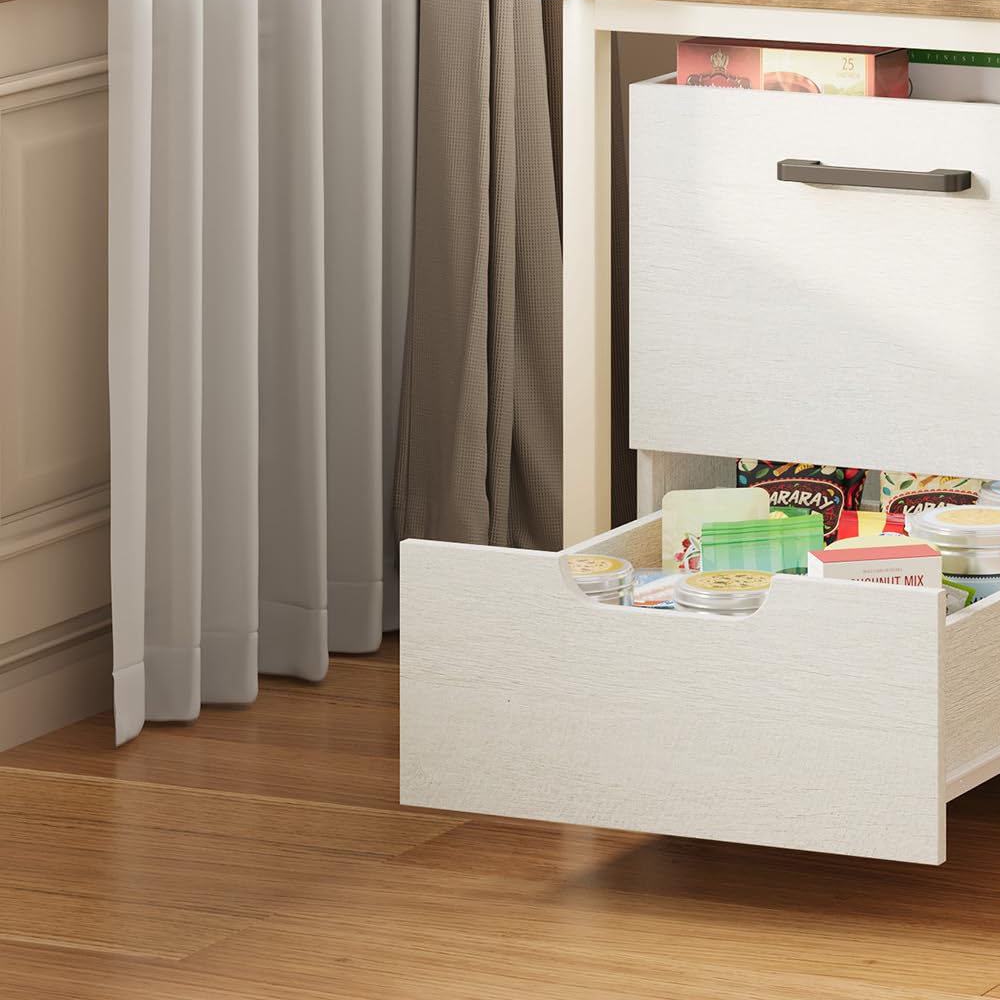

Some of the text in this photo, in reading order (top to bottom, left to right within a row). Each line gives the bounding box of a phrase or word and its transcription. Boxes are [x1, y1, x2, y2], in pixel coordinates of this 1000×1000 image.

[842, 57, 855, 71] 25
[768, 489, 835, 510] ARARAY
[904, 575, 924, 586] MIX
